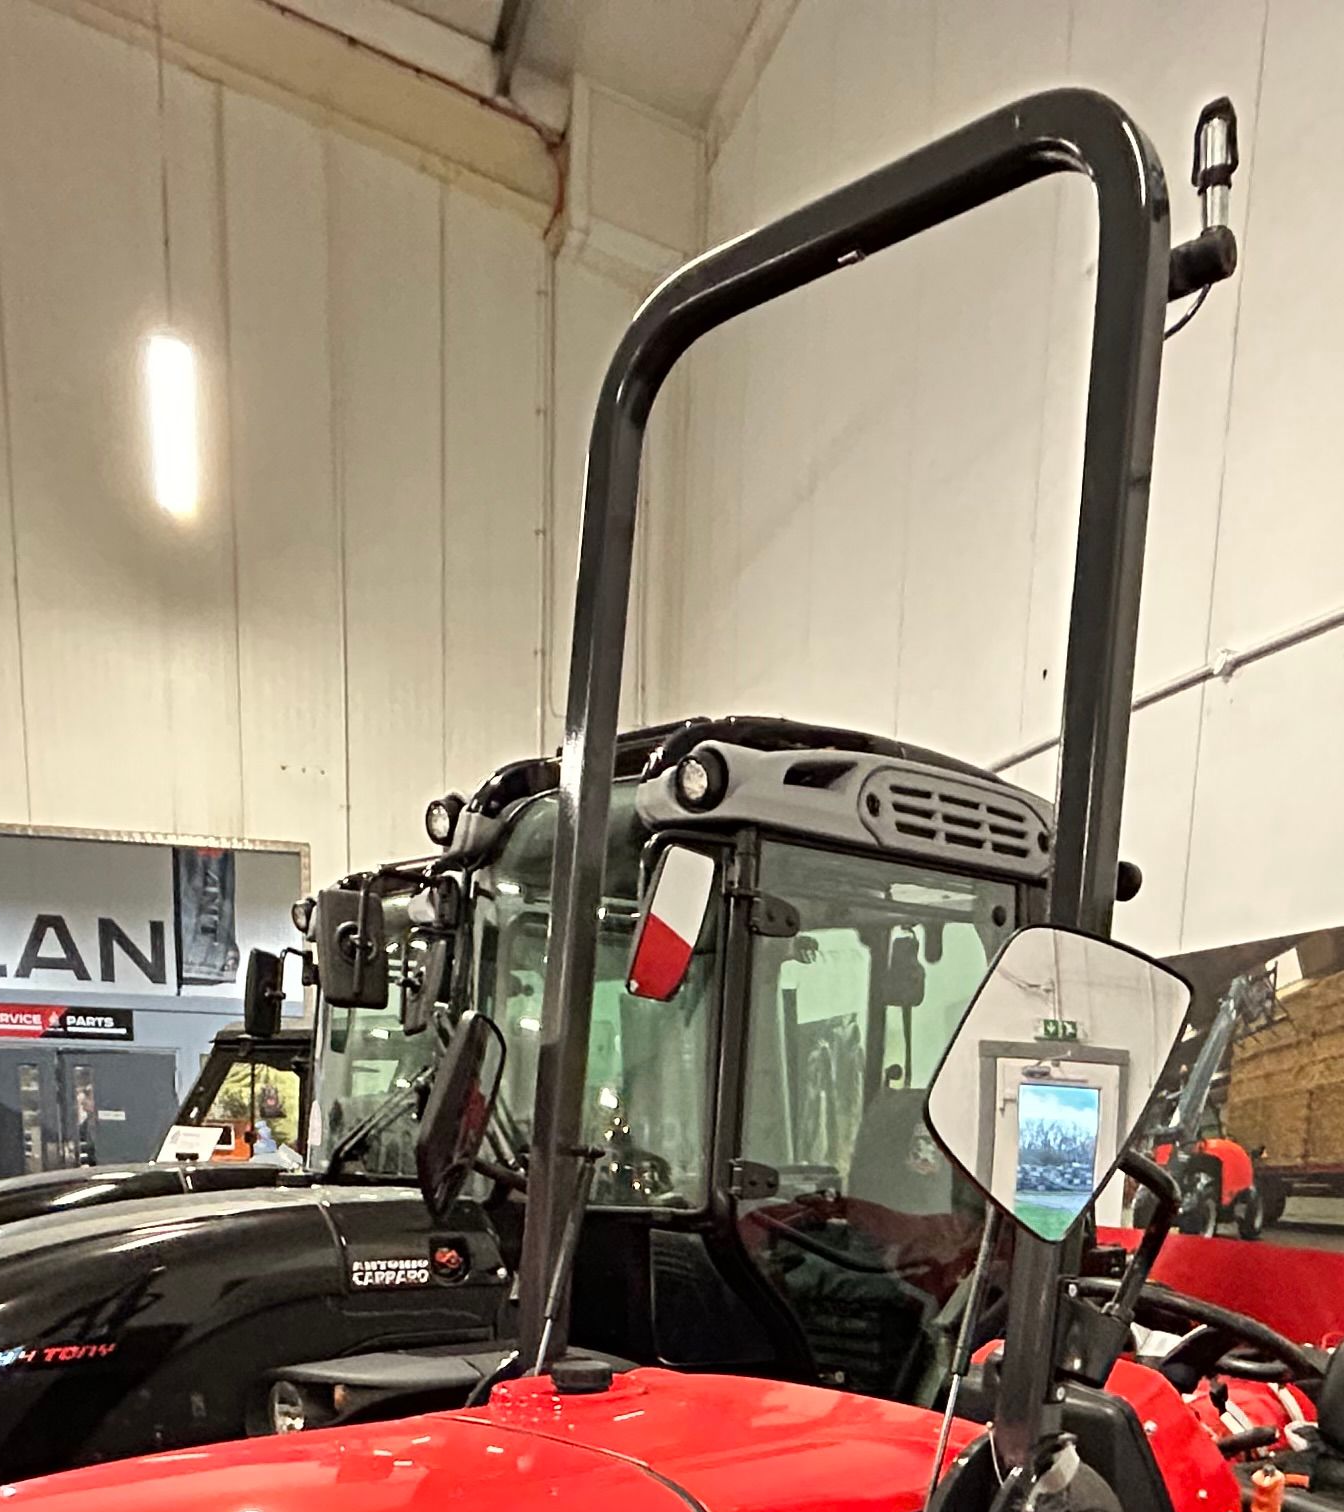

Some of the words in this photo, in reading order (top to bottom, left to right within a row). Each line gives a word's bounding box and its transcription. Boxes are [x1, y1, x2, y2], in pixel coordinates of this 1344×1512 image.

[66, 1015, 115, 1028] PARTS
[352, 1259, 430, 1272] ANTONIO
[351, 1269, 431, 1287] CARRARO
